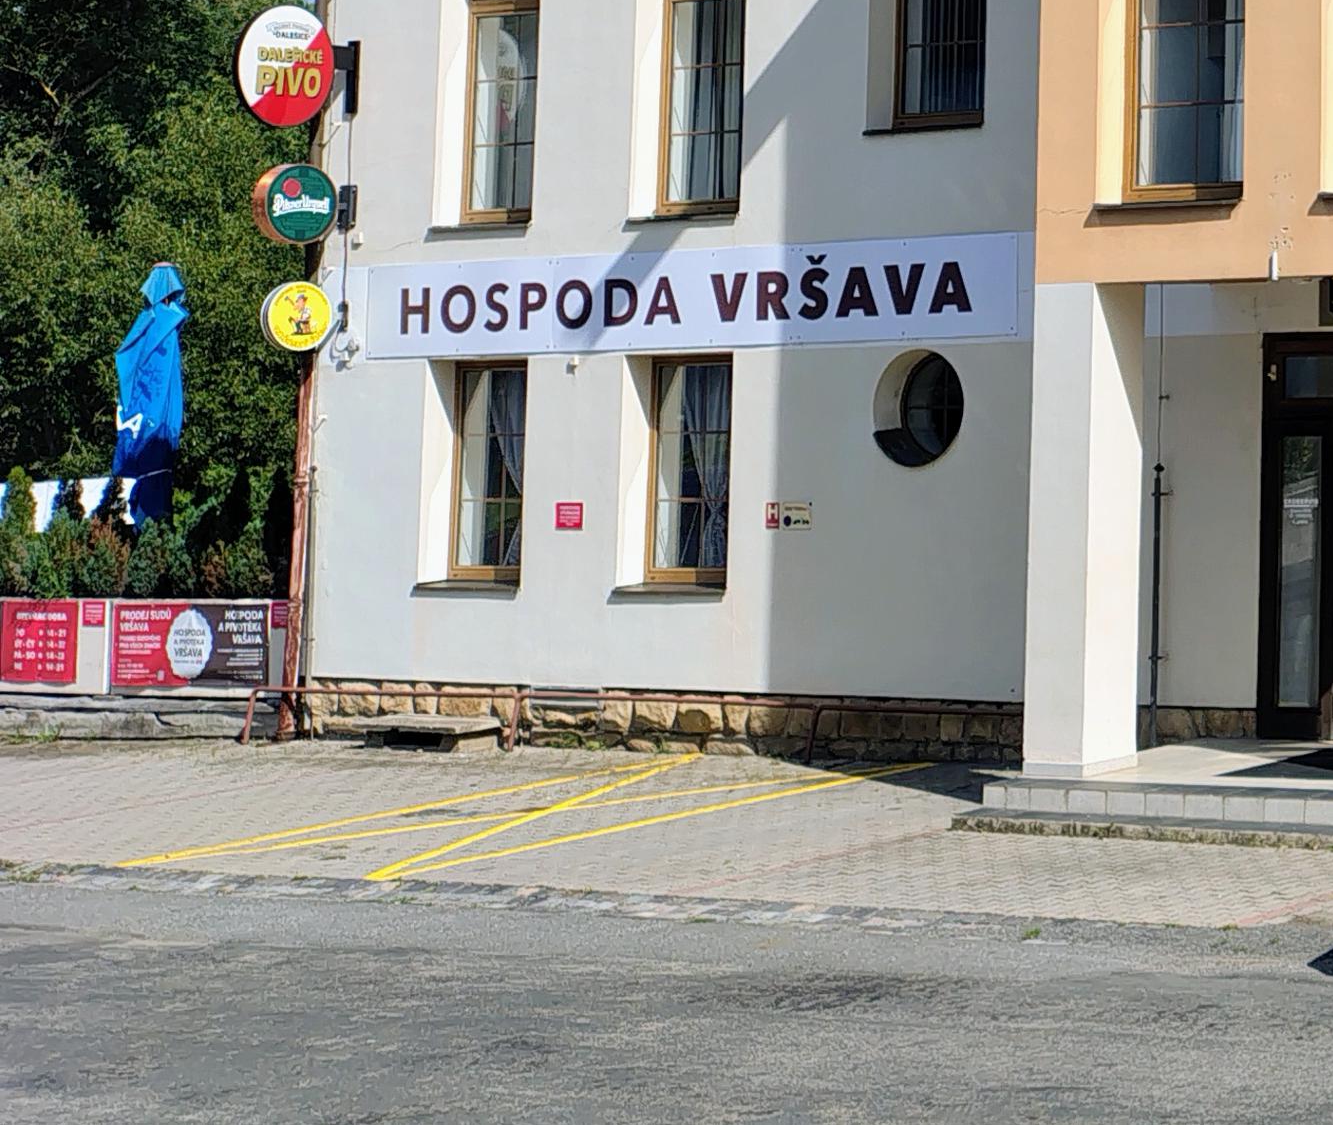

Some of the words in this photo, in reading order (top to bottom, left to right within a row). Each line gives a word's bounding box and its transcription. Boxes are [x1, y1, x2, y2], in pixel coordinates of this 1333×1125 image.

[256, 65, 321, 98] PIVO
[399, 276, 682, 335] HOSPODA
[711, 255, 973, 322] VRŠAVA
[225, 609, 264, 620] HOSPODA
[120, 620, 149, 632] VRŠAVA
[173, 628, 206, 636] HOSPODA
[174, 644, 203, 657] VRŠAVA
